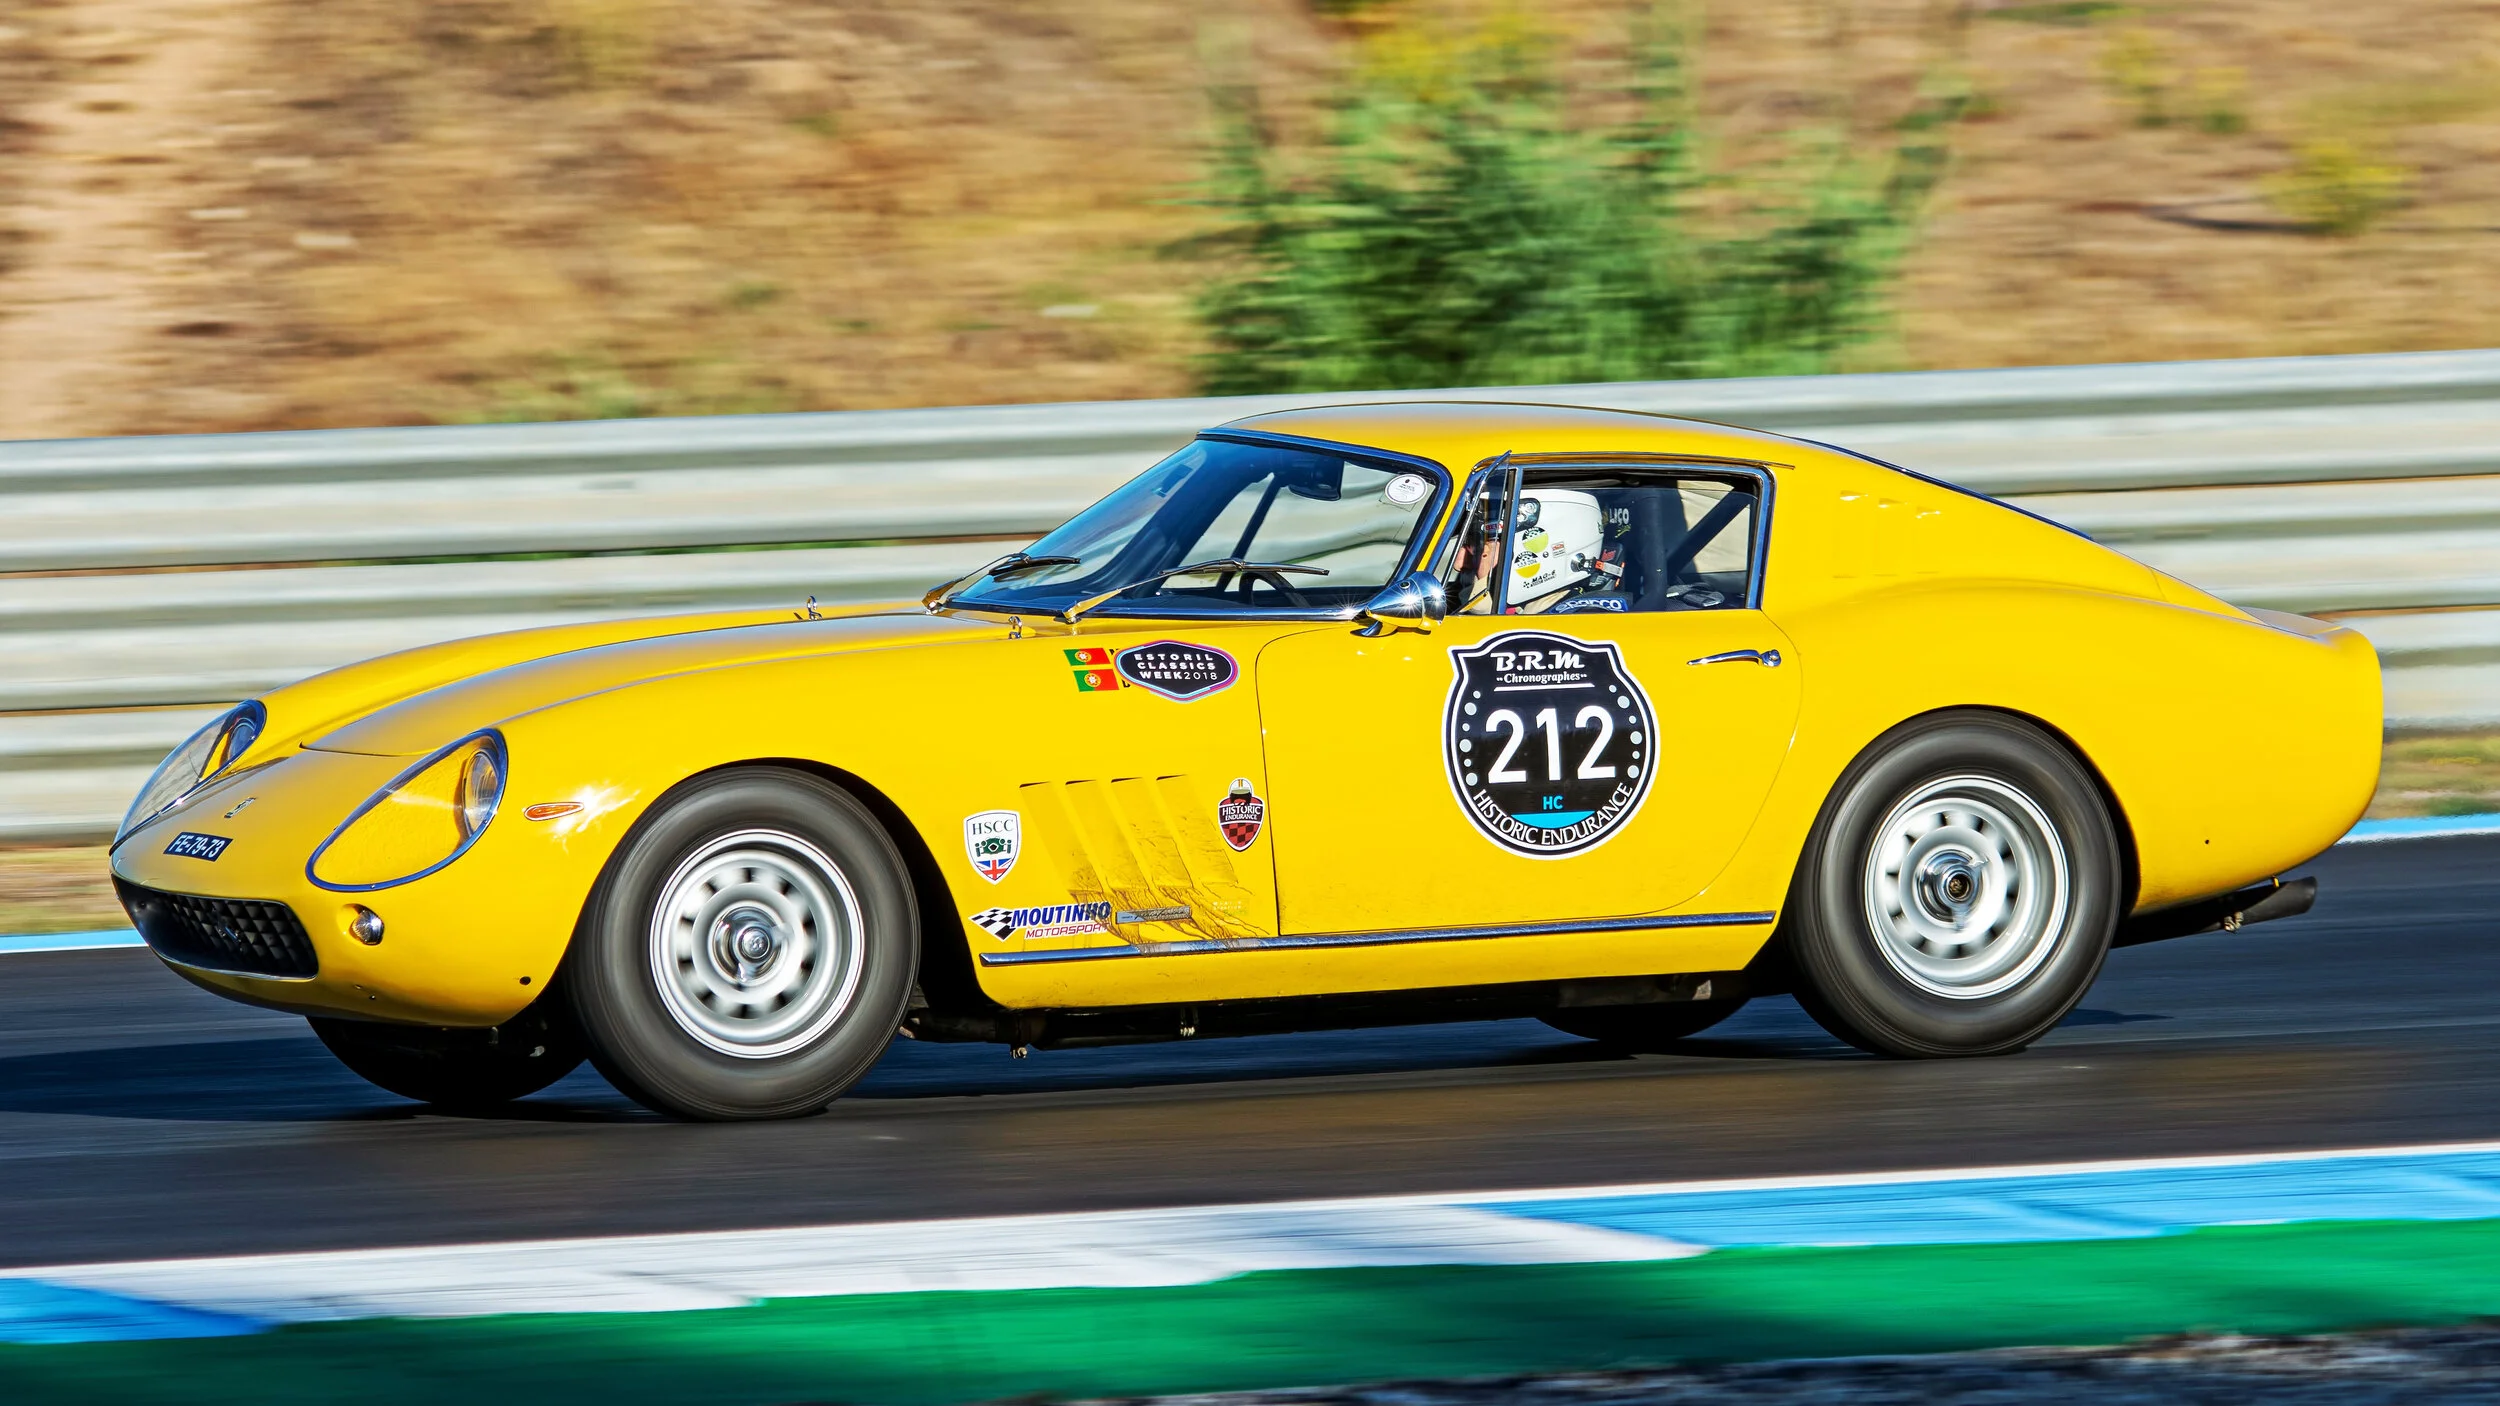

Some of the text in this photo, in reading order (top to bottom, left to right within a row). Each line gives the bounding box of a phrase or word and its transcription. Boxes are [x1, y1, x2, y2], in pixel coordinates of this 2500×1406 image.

[1134, 653, 1213, 661] ESTORIL
[1490, 650, 1585, 671] B.R.M
[1137, 662, 1216, 670] CLASSICS
[1485, 705, 1616, 784] 212
[1222, 805, 1261, 816] HISTORIC
[1543, 795, 1563, 810] HC
[1473, 782, 1633, 845] HISTORIC ENDURANCE
[972, 819, 1014, 835] HSCC
[168, 834, 225, 858] FE-79-73
[1011, 901, 1111, 928] MOUTINHO
[1026, 923, 1110, 938] MOTORSPORT
